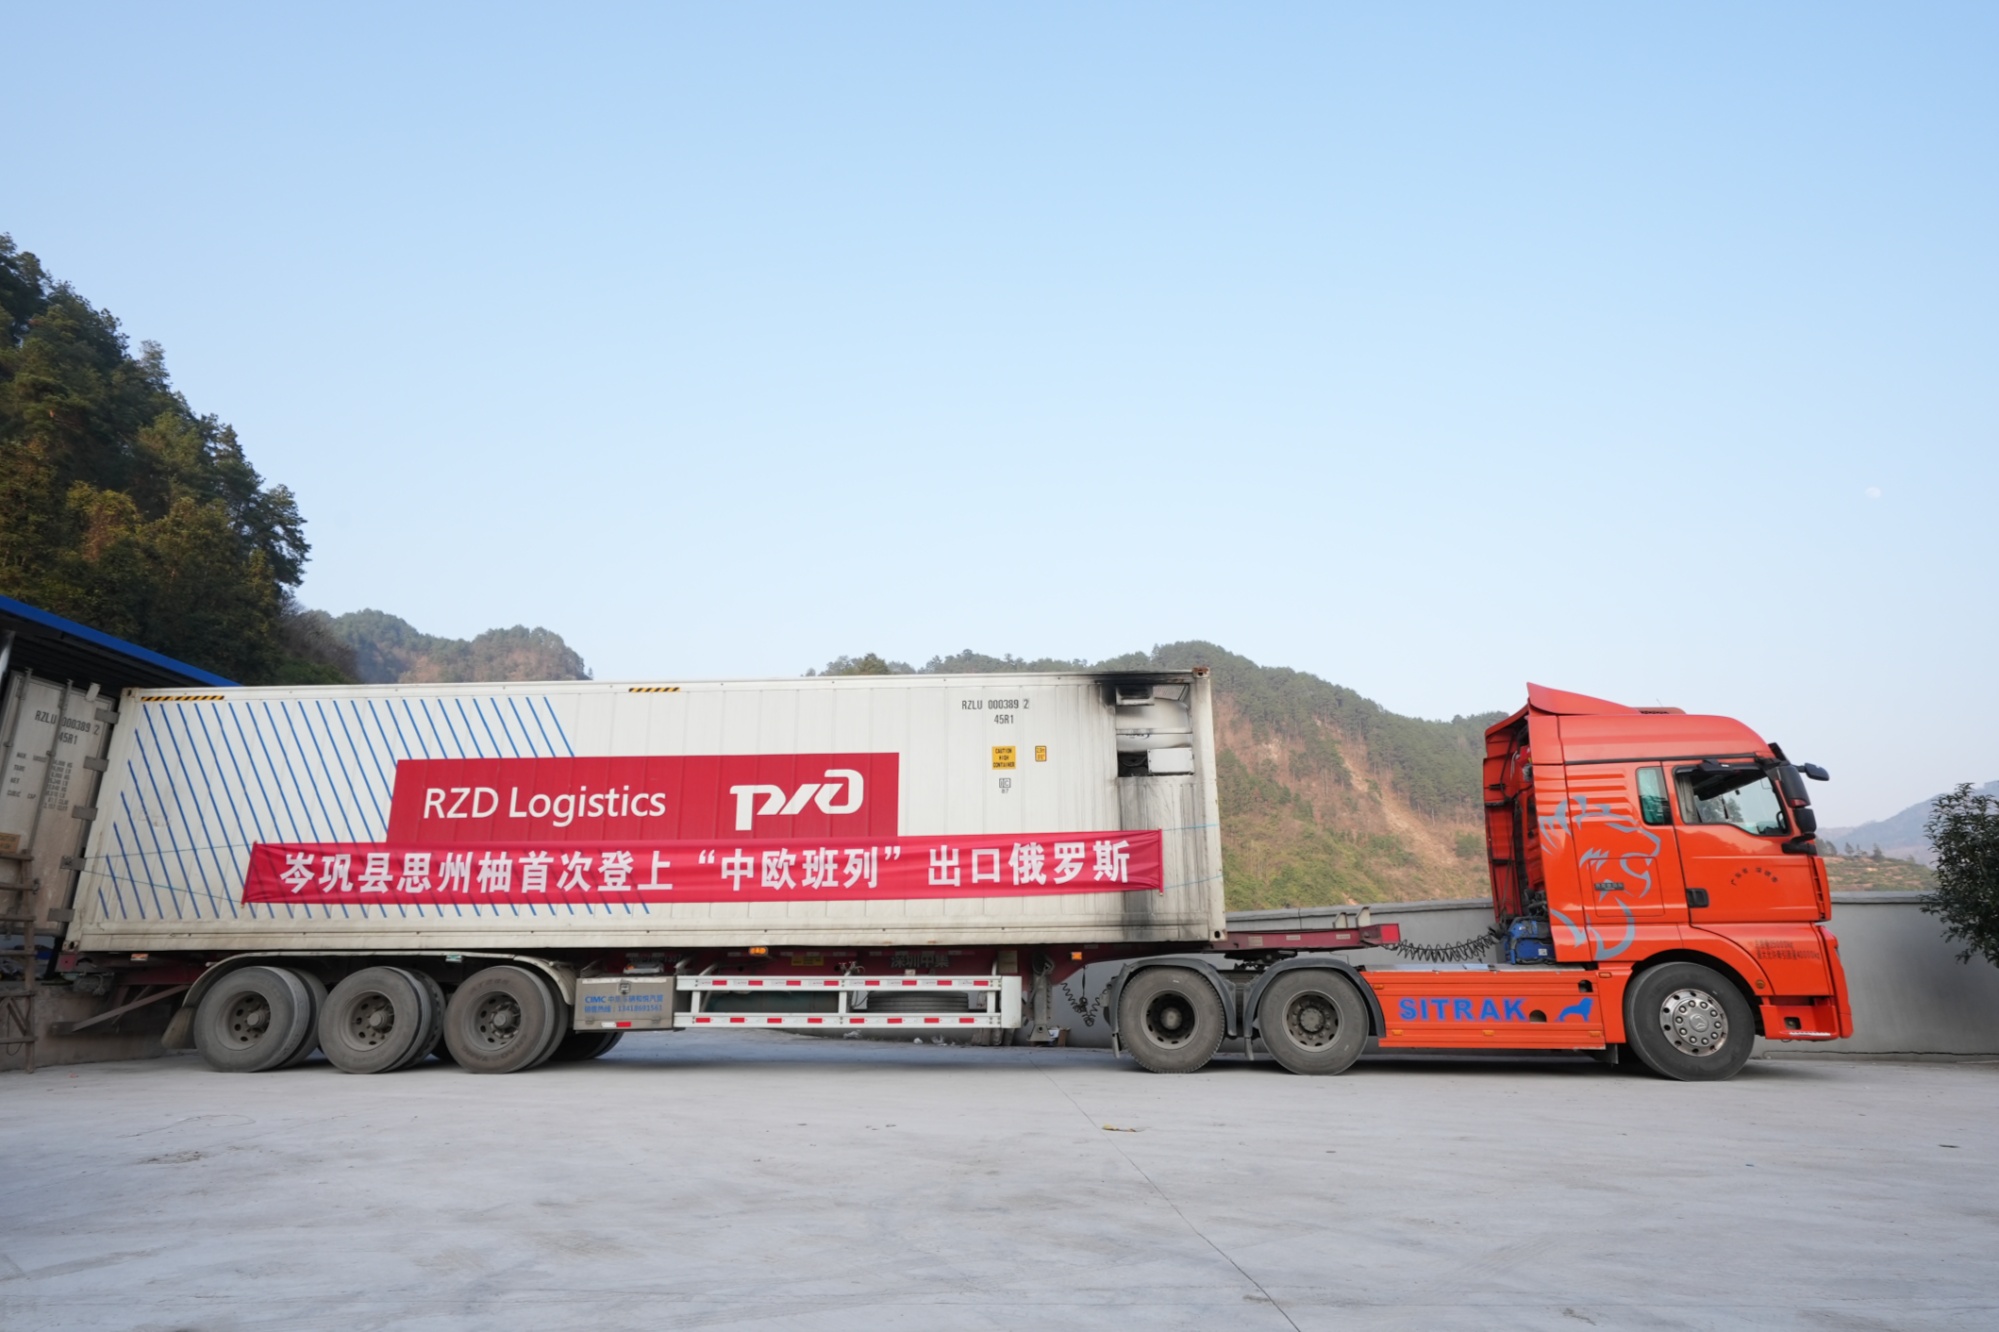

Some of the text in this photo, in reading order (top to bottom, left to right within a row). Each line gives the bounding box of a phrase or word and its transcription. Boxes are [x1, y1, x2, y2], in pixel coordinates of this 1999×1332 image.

[961, 698, 1030, 710] RZLU 000389 2
[34, 709, 58, 725] RZLU
[93, 724, 100, 736] 2
[993, 714, 1014, 725] 45R1
[59, 731, 78, 745] 45R1
[423, 785, 666, 828] RZD Logistics
[1398, 998, 1527, 1022] SITRAK
